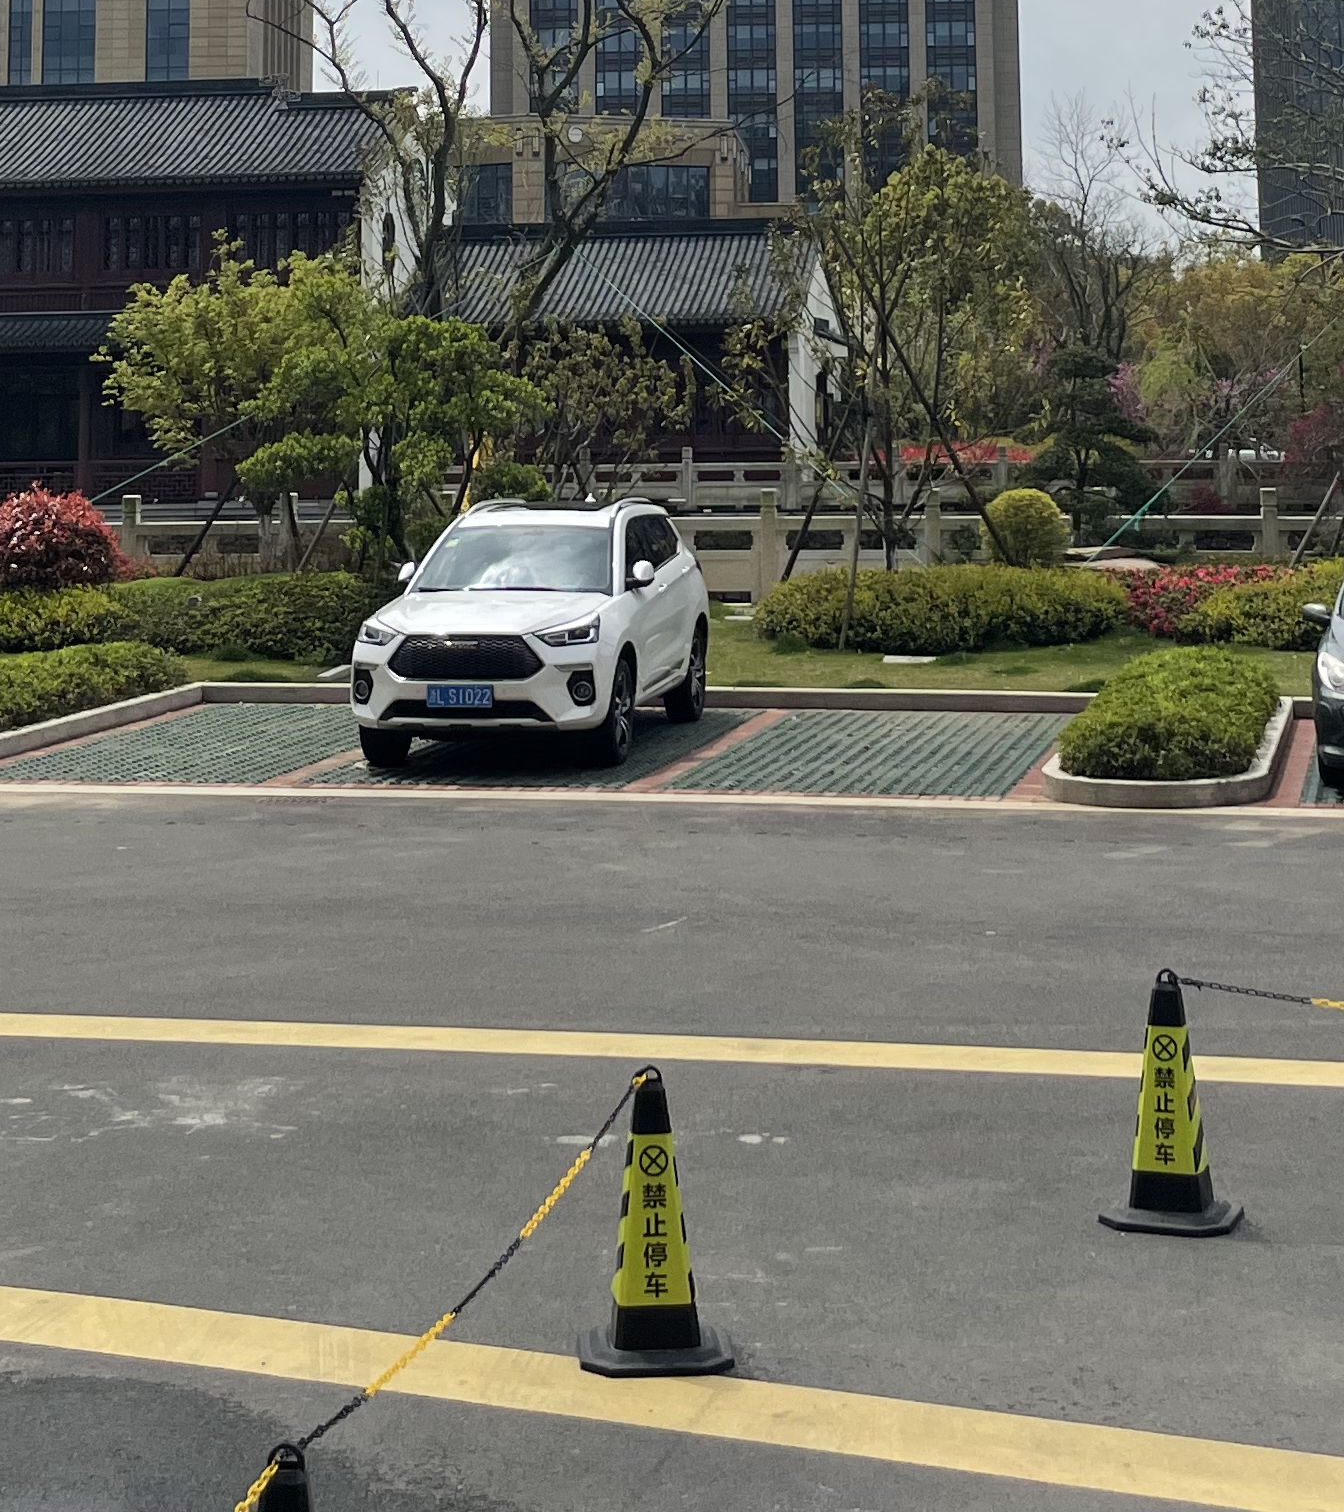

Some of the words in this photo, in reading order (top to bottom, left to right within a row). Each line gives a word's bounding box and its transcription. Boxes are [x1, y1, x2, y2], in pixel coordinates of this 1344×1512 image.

[1153, 1066, 1176, 1166] 禁止停车
[642, 1182, 669, 1298] 禁止停车
